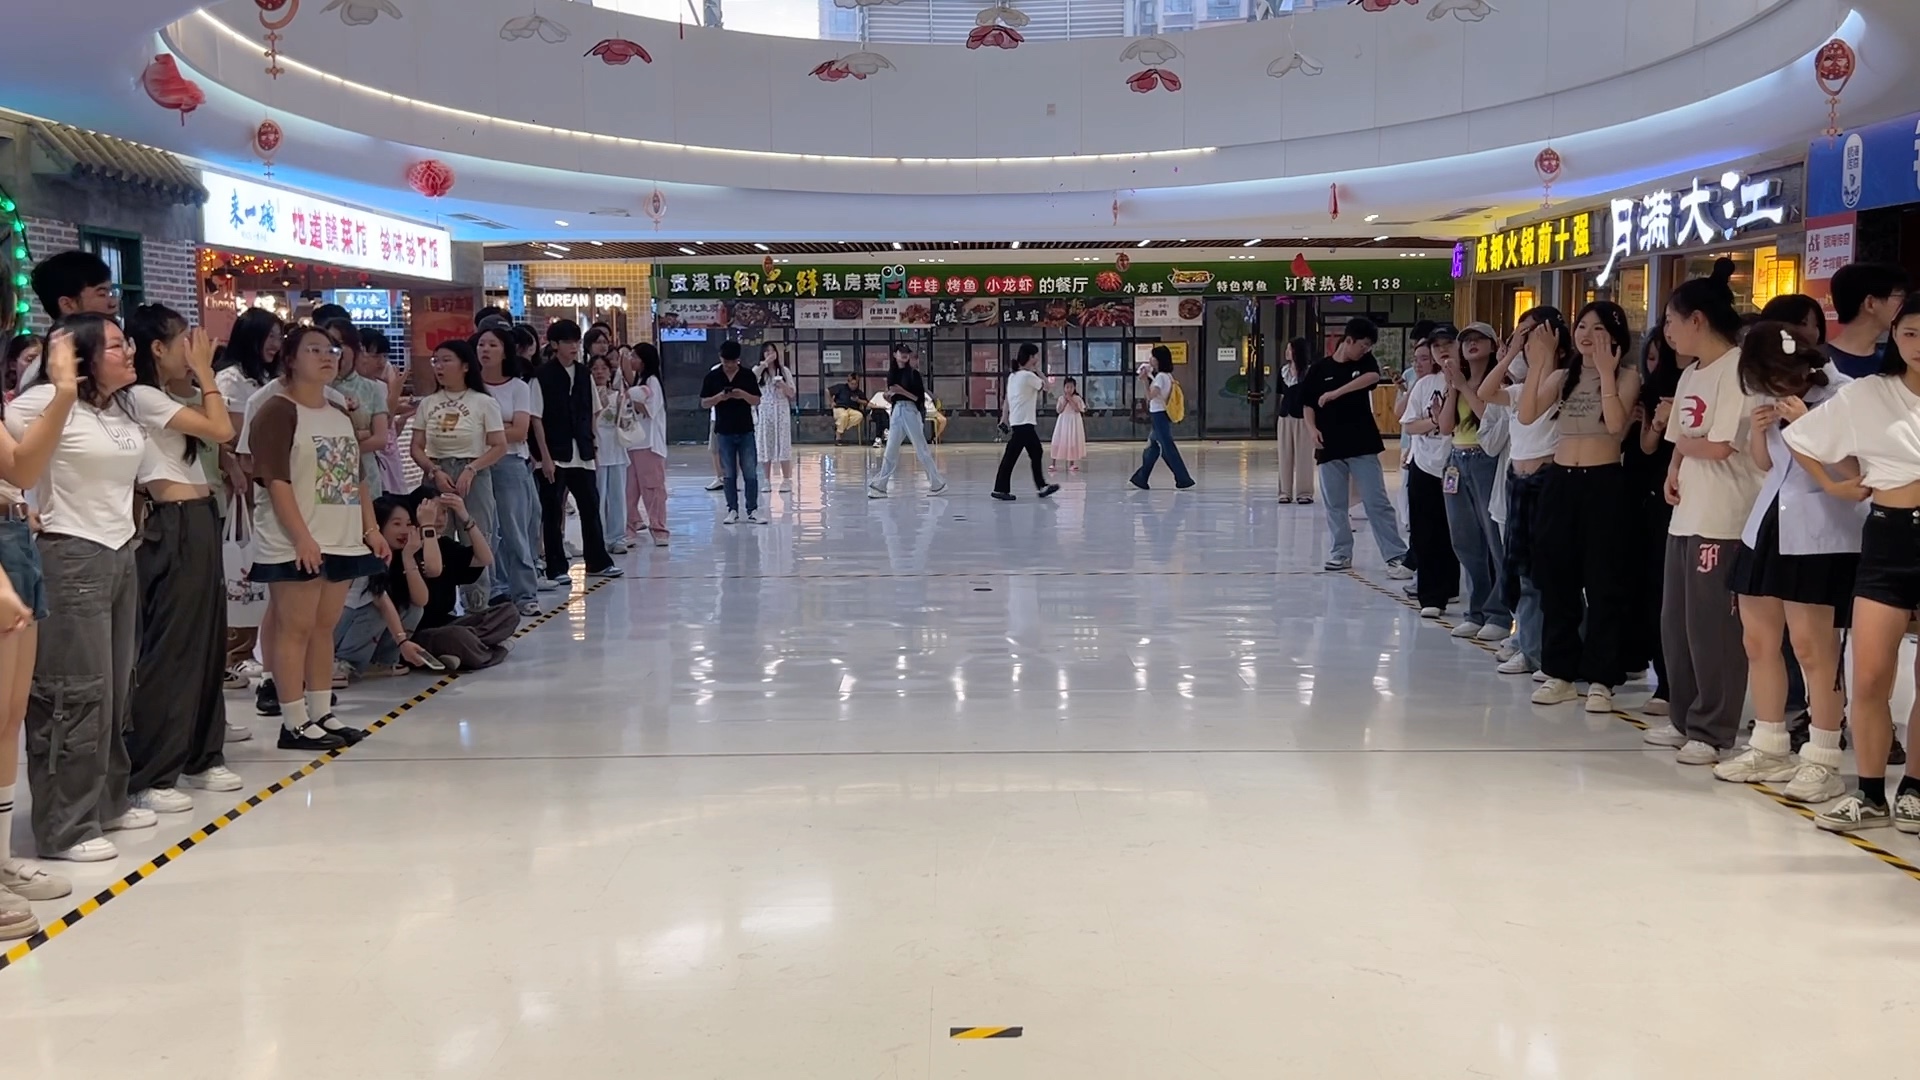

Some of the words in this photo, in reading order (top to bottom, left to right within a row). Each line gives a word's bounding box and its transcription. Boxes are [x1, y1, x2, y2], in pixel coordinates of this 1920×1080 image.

[230, 188, 276, 233] 来一碗
[1596, 171, 1783, 287] 月满大江
[292, 207, 368, 256] 地道赣菜馆
[380, 226, 439, 268] 够味够下饭
[1475, 213, 1590, 273] 成都火锅前十强
[537, 294, 588, 307] KOREAN
[908, 279, 938, 293] 牛蛙
[947, 279, 977, 293] 烤鱼
[986, 278, 1033, 293] 小龙虾
[1039, 277, 1089, 293] 的餐厅
[1123, 282, 1164, 294] 小龙虾
[1216, 280, 1268, 292] 特色烤鱼
[1372, 278, 1400, 290] 138
